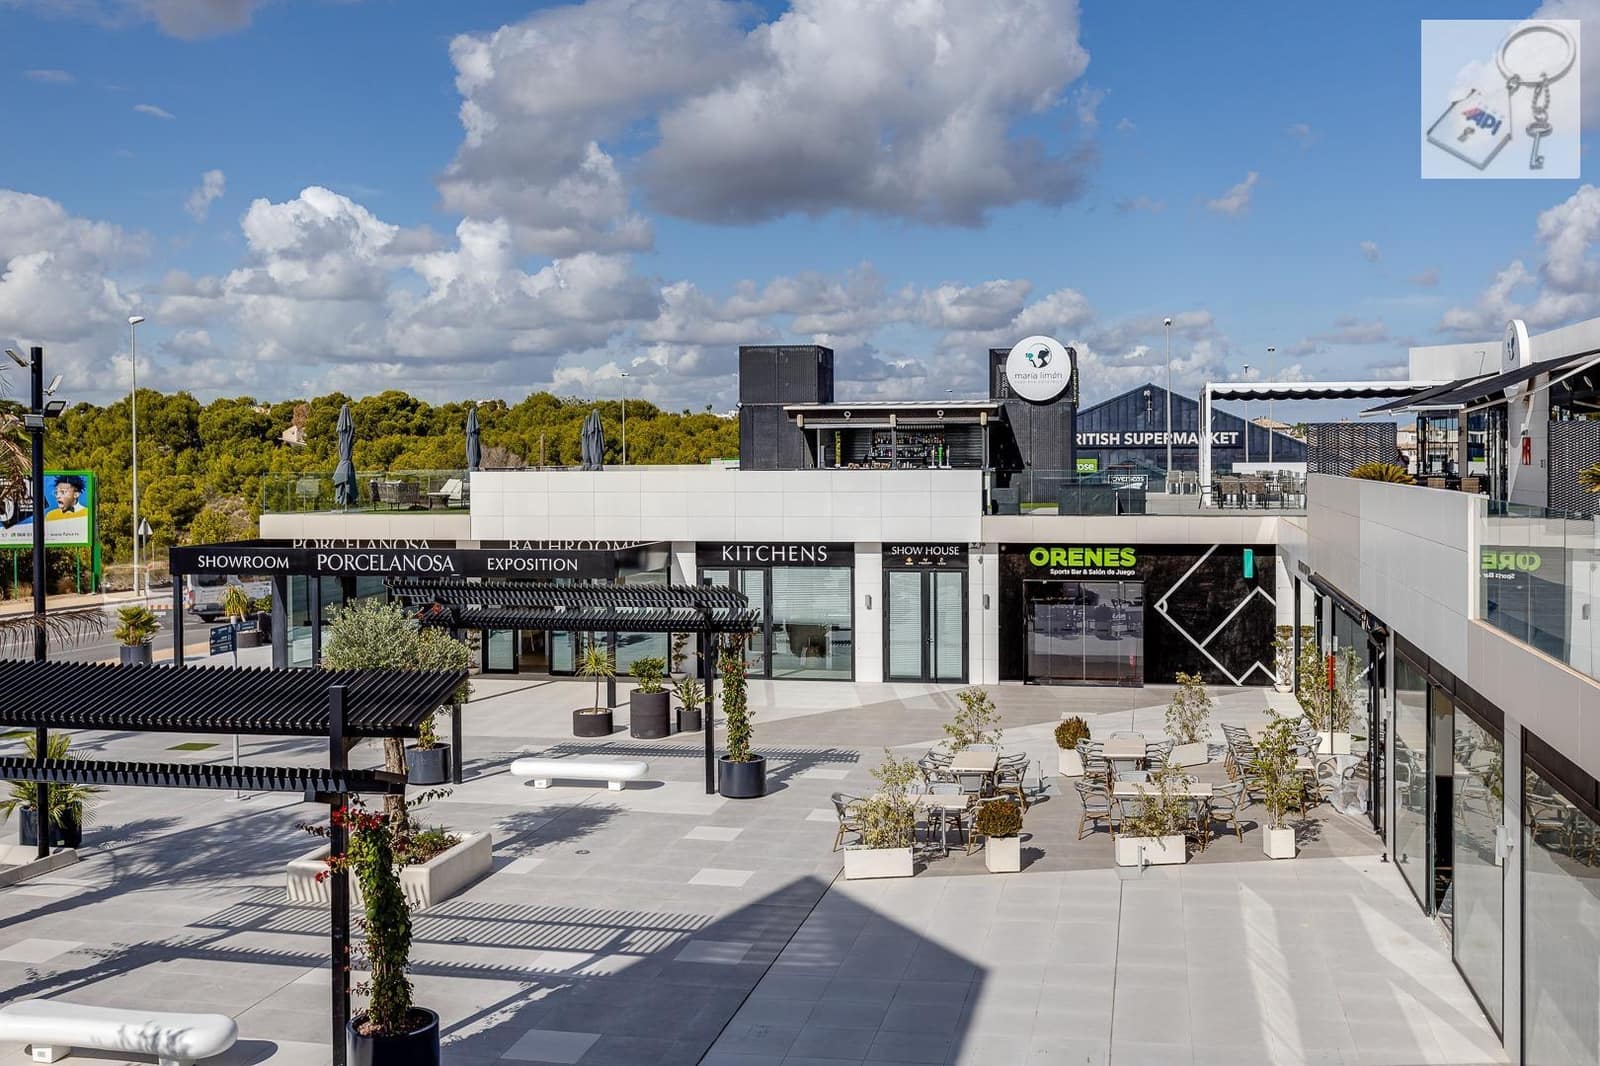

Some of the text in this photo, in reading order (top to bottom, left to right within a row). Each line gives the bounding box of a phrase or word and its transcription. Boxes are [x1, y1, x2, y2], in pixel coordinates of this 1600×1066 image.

[1123, 431, 1239, 445] SUPERMAKET
[722, 545, 828, 562] KITCHENS
[891, 546, 960, 555] SHOW HOUSE
[1029, 547, 1136, 567] ORENES
[198, 555, 289, 569] SHOWROOM
[317, 553, 455, 571] PORCELANOSA
[487, 557, 578, 571] EXPOSITION
[1115, 569, 1136, 577] Juego
